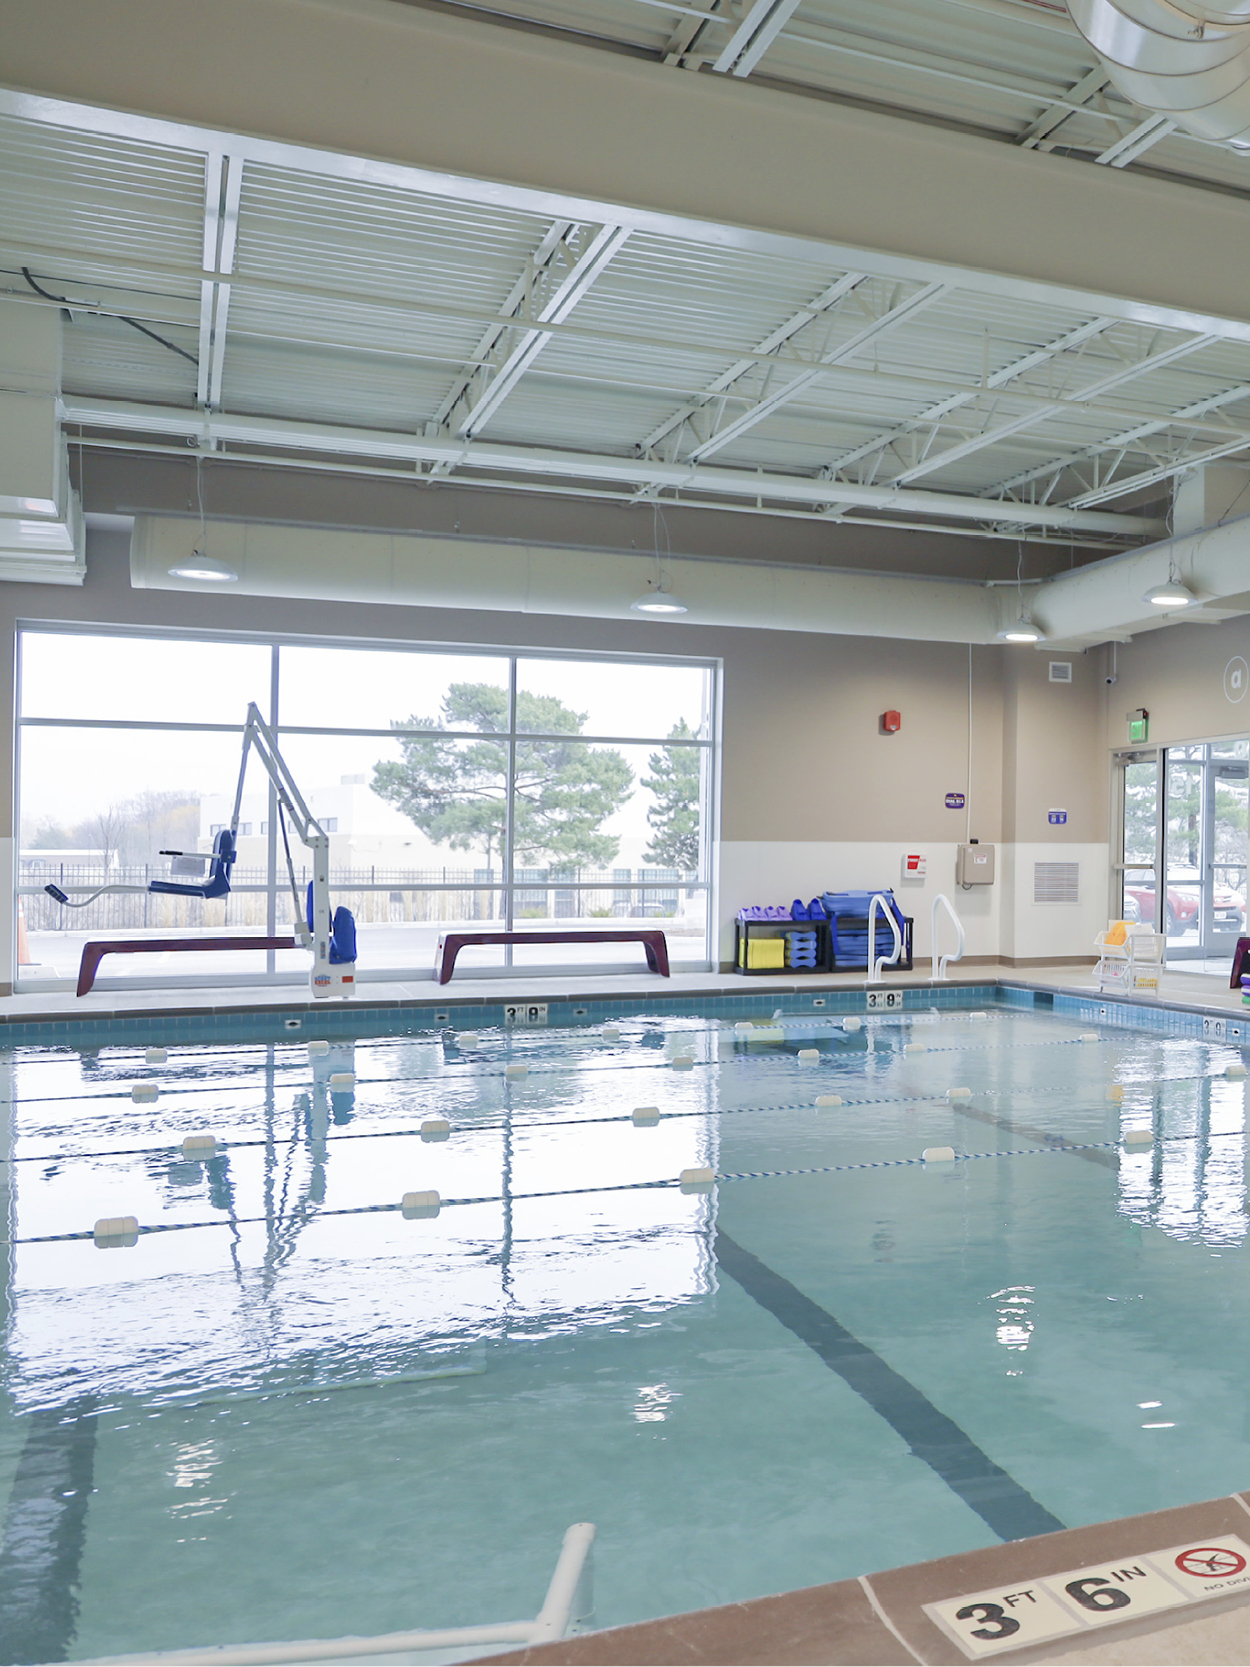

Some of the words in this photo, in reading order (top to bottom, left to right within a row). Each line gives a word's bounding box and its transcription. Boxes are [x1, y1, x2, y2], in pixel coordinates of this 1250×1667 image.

[1230, 668, 1242, 689] a
[1204, 1583, 1224, 1591] NO
[955, 1603, 1021, 1640] 3
[1002, 1589, 1037, 1608] FT
[1064, 1577, 1132, 1612] 6
[1109, 1565, 1147, 1583] IN
